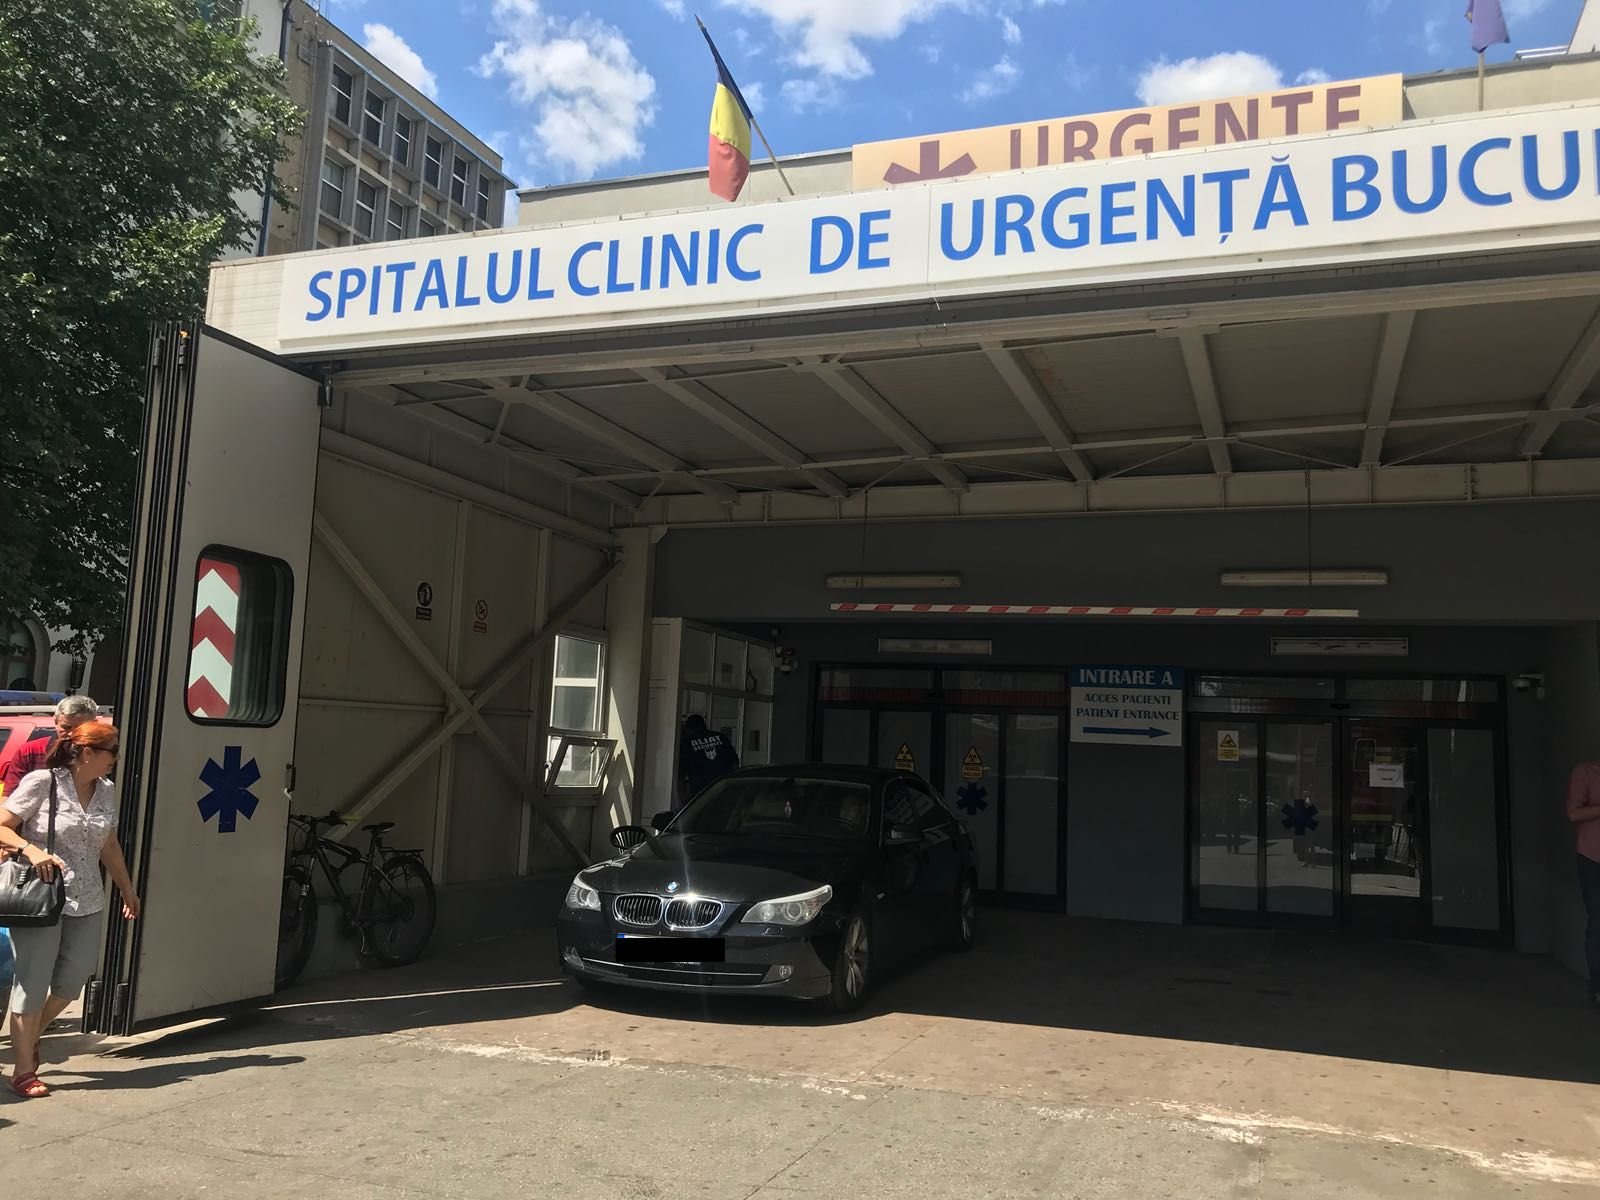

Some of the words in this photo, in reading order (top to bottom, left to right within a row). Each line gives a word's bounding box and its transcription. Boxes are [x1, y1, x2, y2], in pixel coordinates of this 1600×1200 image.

[306, 247, 554, 321] SPITALUL
[567, 223, 763, 302] CLINIC
[809, 209, 890, 275] DE
[940, 154, 1308, 261] URGENȚĂ
[1332, 129, 1600, 221] BUCU
[1079, 668, 1157, 685] INTRARE
[1161, 670, 1174, 686] A
[1085, 693, 1118, 703] ACCES
[1076, 707, 1120, 718] PATIENT
[1123, 709, 1180, 720] ENTRANCE
